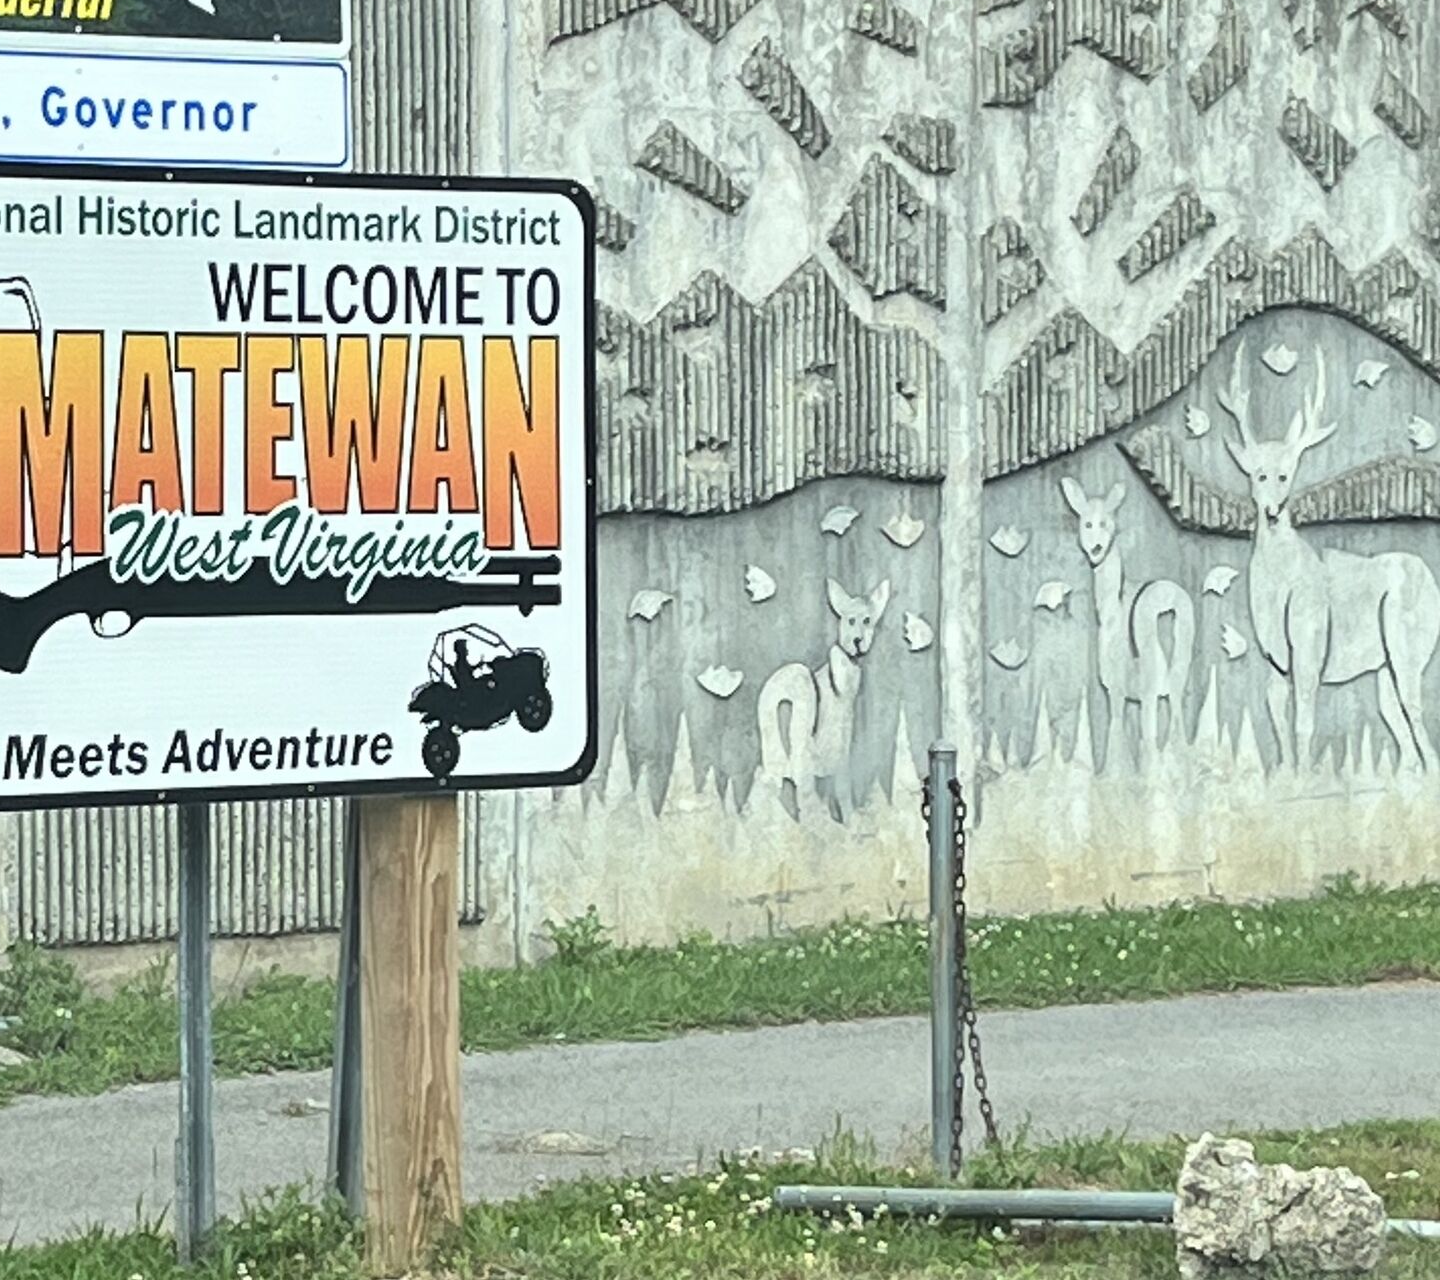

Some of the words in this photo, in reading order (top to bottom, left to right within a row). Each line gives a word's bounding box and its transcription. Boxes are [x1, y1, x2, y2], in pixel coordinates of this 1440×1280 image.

[41, 86, 258, 131] Governor
[78, 195, 221, 237] Historic
[234, 199, 422, 243] Landmark
[435, 206, 561, 245] District
[208, 261, 484, 325] WELCOME
[497, 267, 561, 326] TO
[109, 509, 253, 578] West
[261, 505, 486, 598] Virginia
[2, 734, 149, 780] Meets
[161, 726, 394, 774] Adventure
